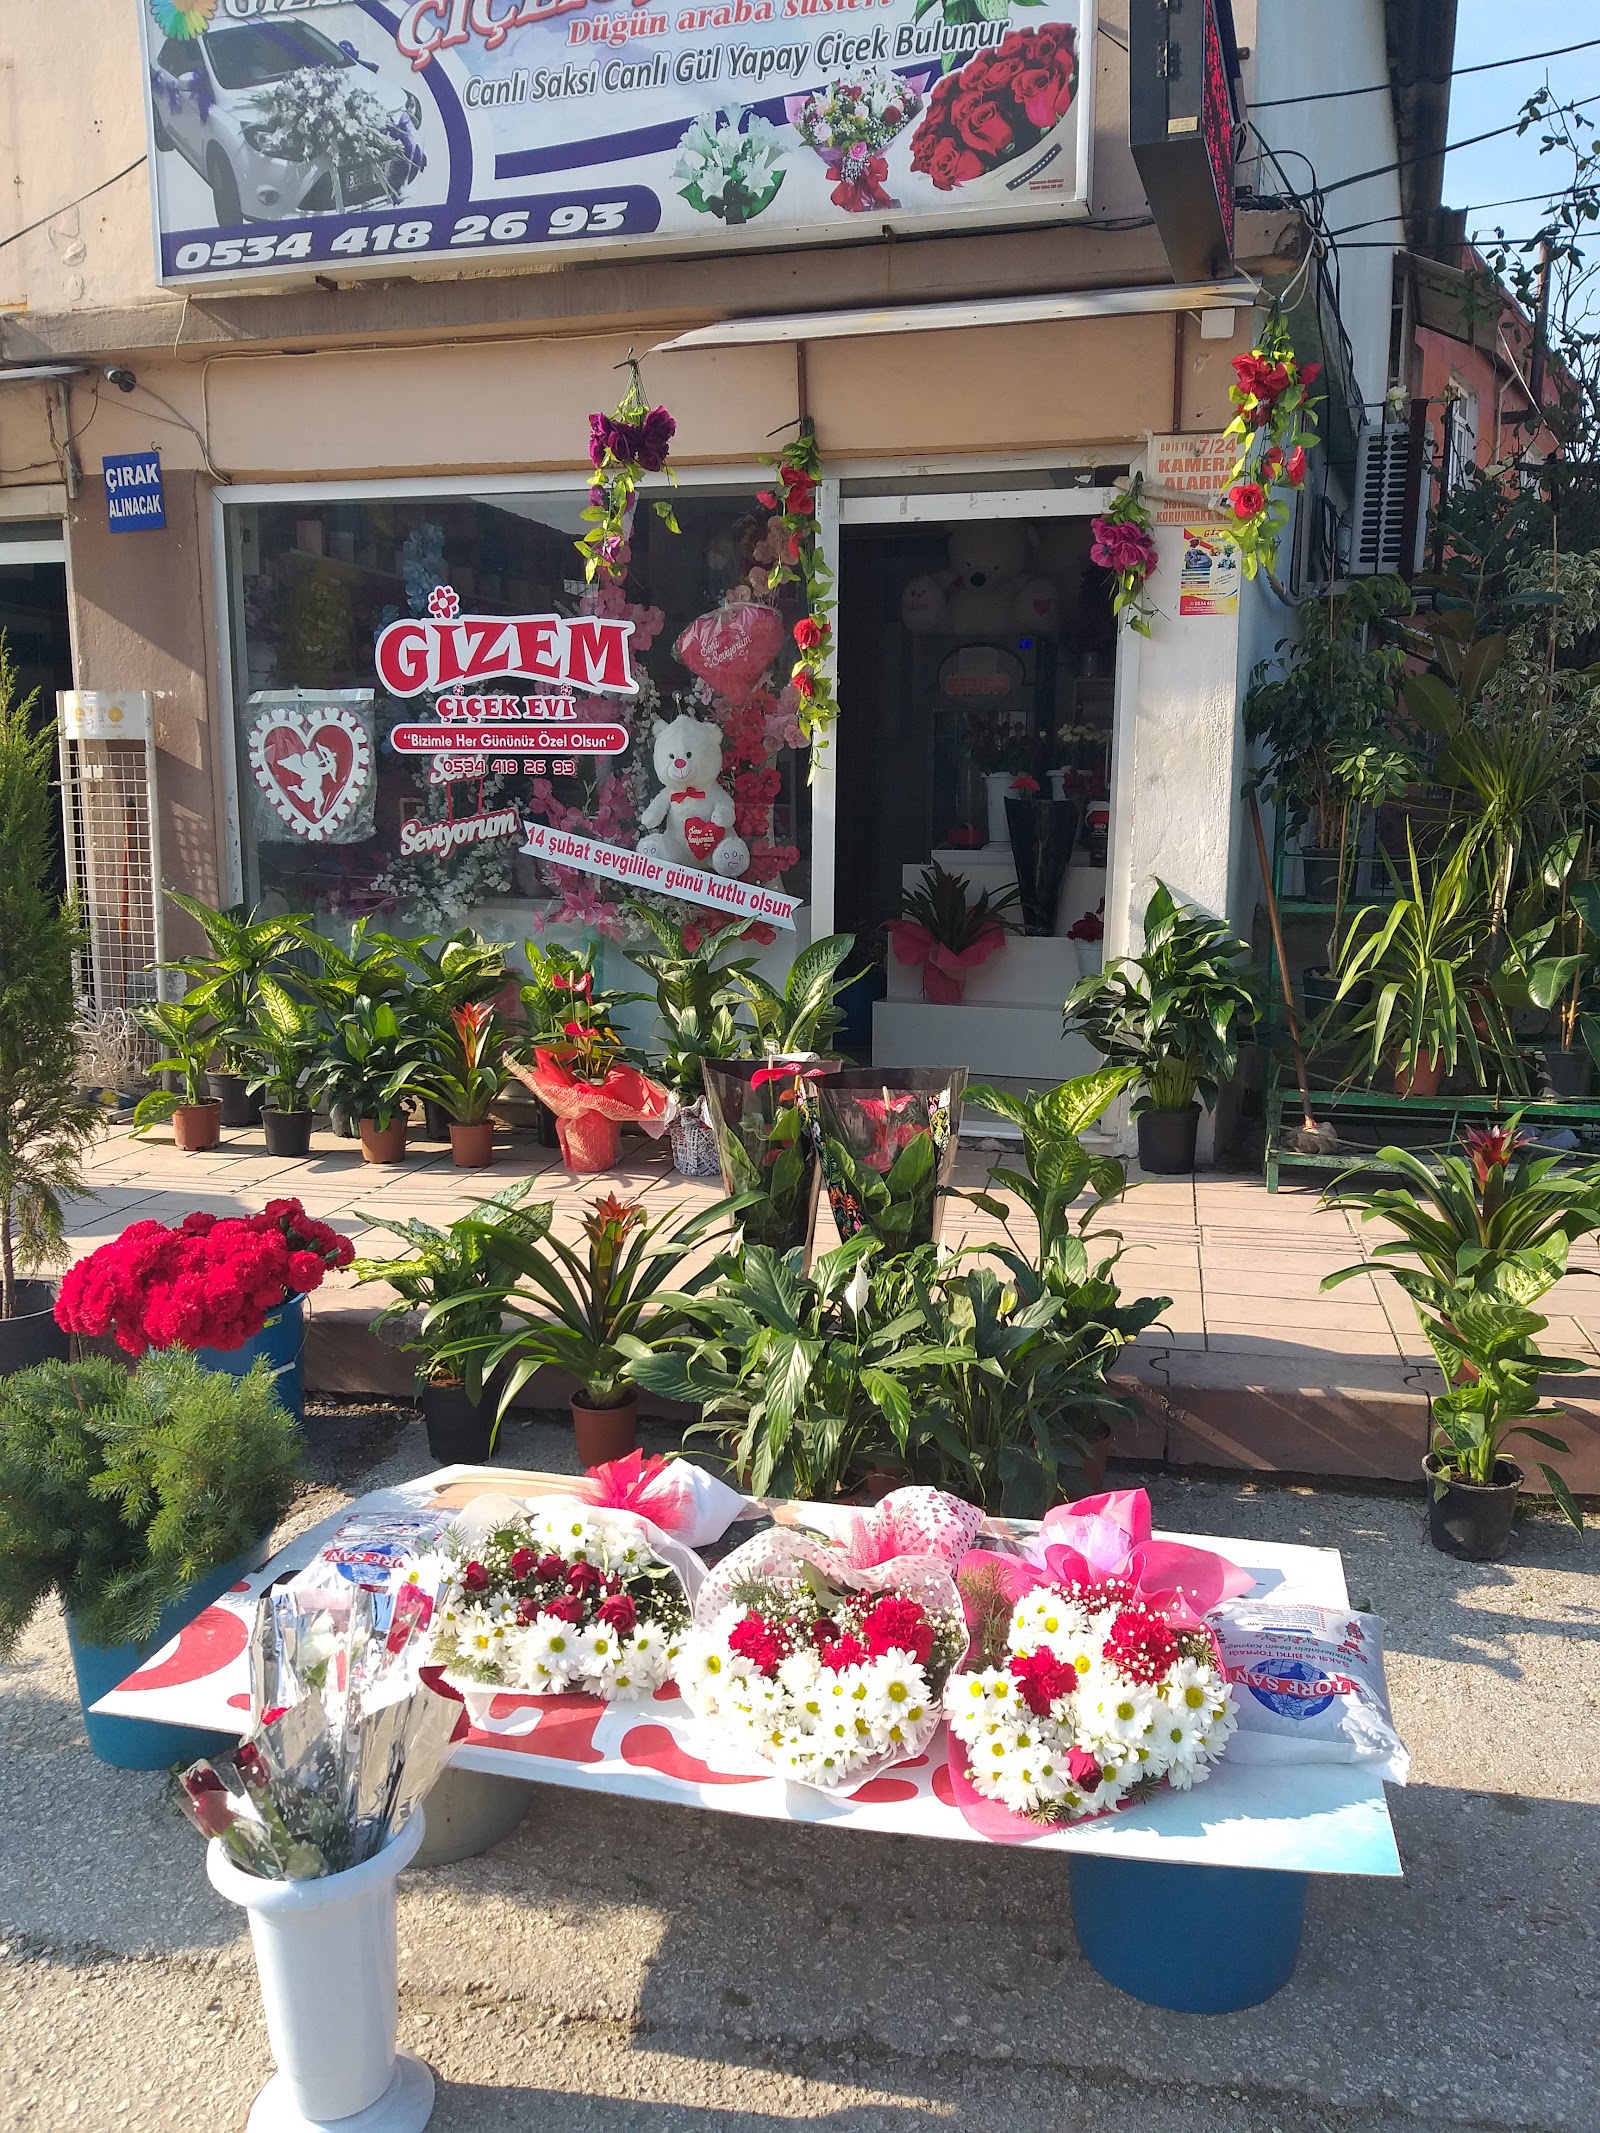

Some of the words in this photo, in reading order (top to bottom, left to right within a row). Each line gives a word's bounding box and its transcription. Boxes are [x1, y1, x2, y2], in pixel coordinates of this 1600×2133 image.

[569, 12, 666, 46] Düğün
[678, 0, 772, 30] araba
[466, 70, 524, 106] Canlı
[605, 54, 667, 90] Canlı
[677, 47, 720, 82] Gül
[730, 44, 809, 80] Yapay
[817, 27, 887, 72] Çiçek
[898, 18, 1010, 57] Bulunur
[175, 232, 312, 269] 0534
[331, 220, 433, 254] 418
[450, 211, 529, 244] 26
[548, 202, 629, 232] 93
[1199, 438, 1237, 454] 7/24
[105, 463, 160, 493] ÇIRAK
[109, 494, 162, 518] ALINACAK
[376, 588, 638, 697] GİZEM
[437, 685, 521, 723] ÇİÇEK
[523, 685, 577, 720] EVİ
[456, 733, 478, 747] Her
[480, 733, 535, 748] Gününüz
[538, 730, 567, 748] Özel
[443, 759, 486, 774] 0534
[491, 759, 518, 774] 418
[523, 759, 546, 775] 26
[552, 759, 576, 775] 93
[528, 826, 545, 848] 14
[548, 834, 589, 861] şubat
[593, 847, 663, 881] sevgililer
[665, 866, 703, 892] günü
[707, 875, 745, 906] kutlu
[749, 891, 792, 919] olsun
[329, 1551, 367, 1563] SAN
[1319, 1654, 1350, 1668] SAKSI
[1234, 1670, 1280, 1691] SAN
[1286, 1680, 1348, 1696] TORF
